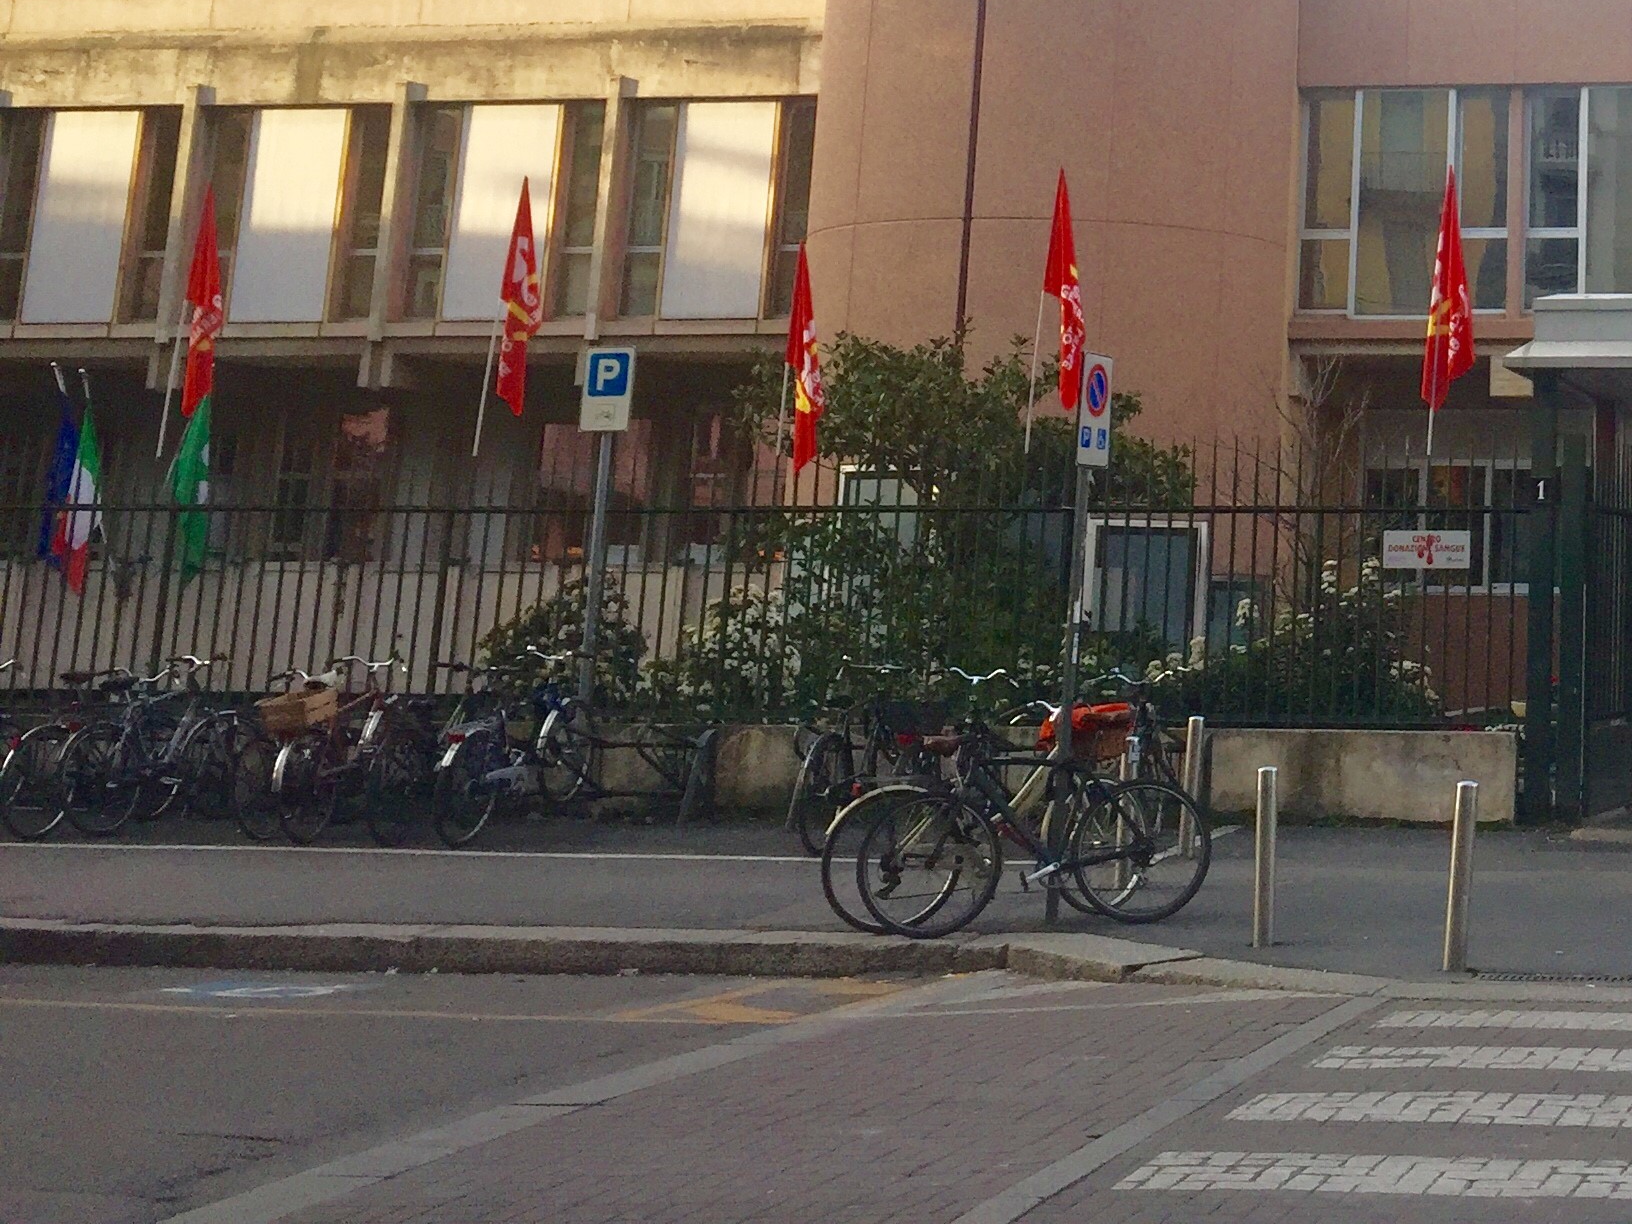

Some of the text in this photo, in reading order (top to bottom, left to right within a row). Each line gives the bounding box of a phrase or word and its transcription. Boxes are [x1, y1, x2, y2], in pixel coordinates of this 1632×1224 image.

[596, 359, 620, 391] P
[1536, 480, 1545, 500] 1
[1412, 535, 1442, 543] CENRO
[1387, 544, 1466, 553] DONAZION SANGUE
